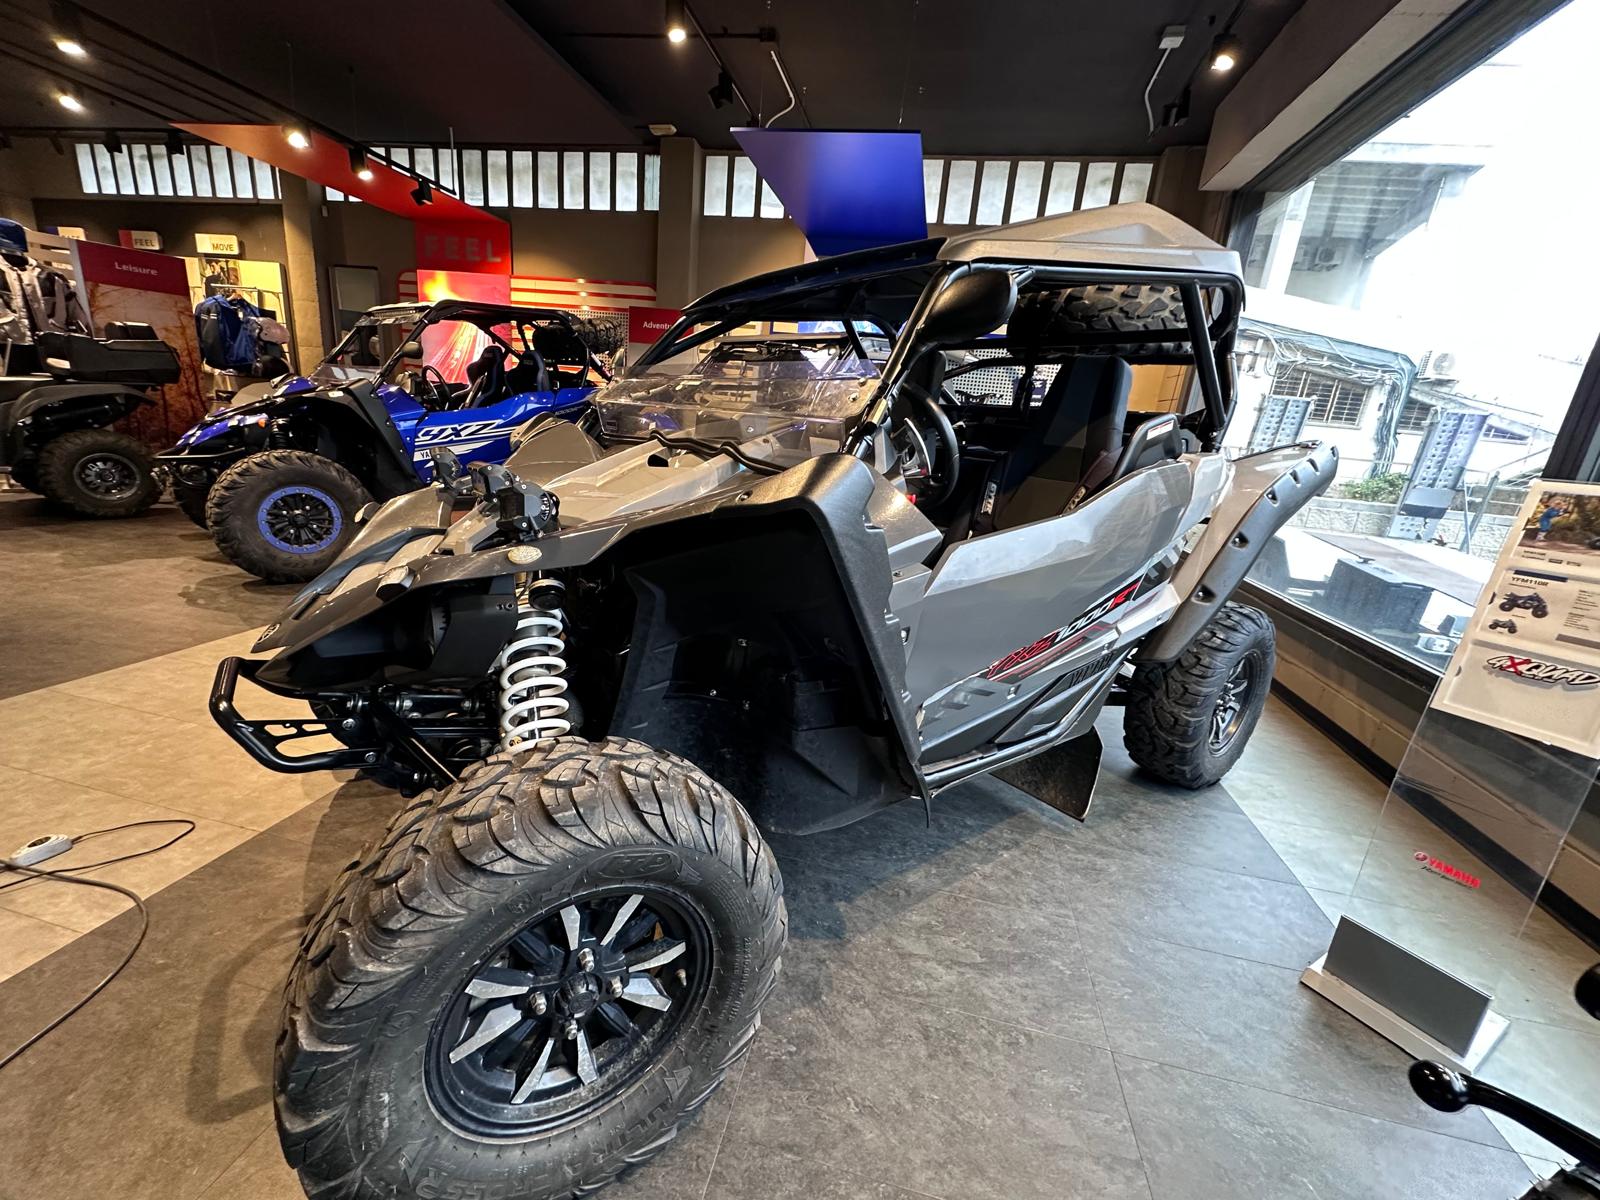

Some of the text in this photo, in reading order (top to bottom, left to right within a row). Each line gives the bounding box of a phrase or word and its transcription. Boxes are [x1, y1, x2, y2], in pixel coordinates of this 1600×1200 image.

[134, 237, 156, 248] FEEL
[212, 242, 235, 252] MOVE
[424, 235, 502, 263] FEEL
[114, 261, 159, 276] Leisure
[642, 320, 673, 330] Adventu
[417, 420, 503, 442] YXZ
[1428, 857, 1481, 889] YAMAHA
